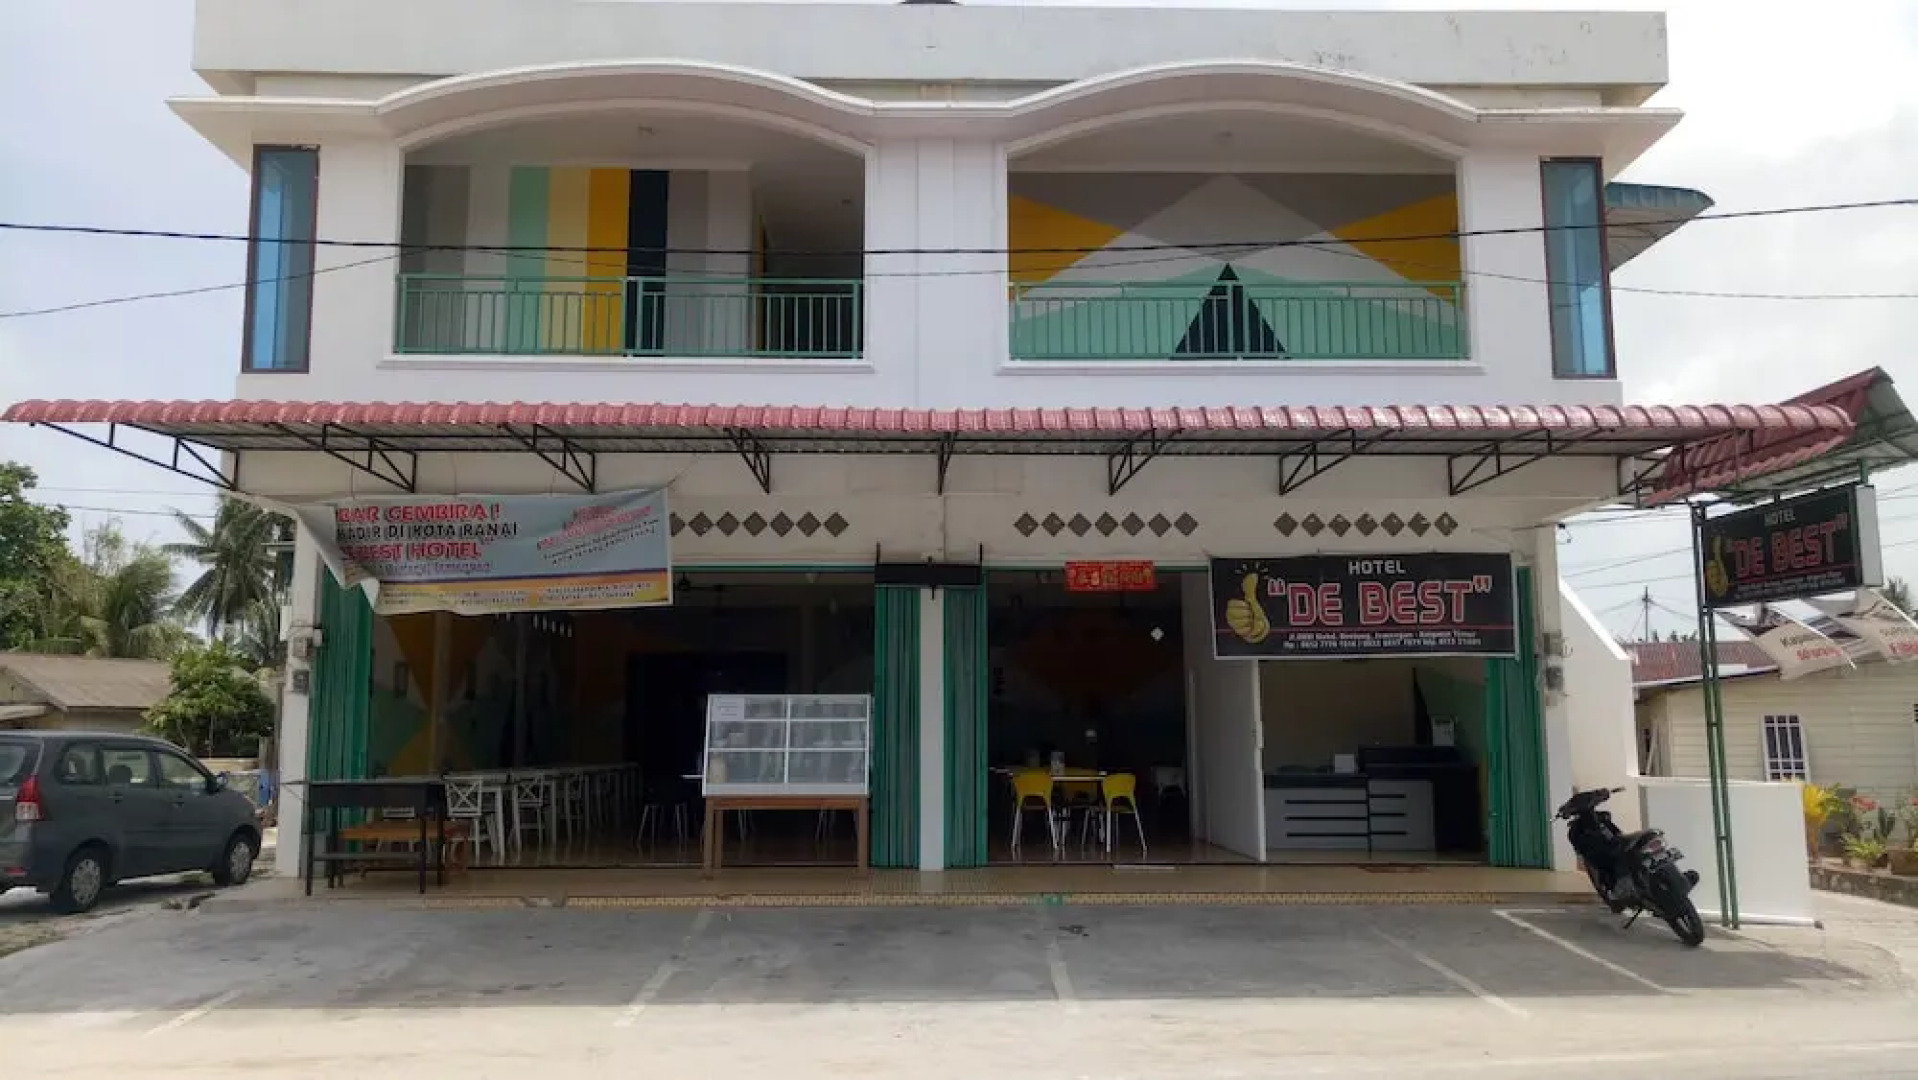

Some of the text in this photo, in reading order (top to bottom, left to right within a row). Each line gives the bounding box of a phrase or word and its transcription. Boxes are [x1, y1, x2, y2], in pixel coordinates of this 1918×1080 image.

[385, 503, 488, 522] GEMBIRA
[387, 525, 404, 538] DI
[411, 524, 456, 538] KOTA
[461, 521, 517, 538] RANAI
[1348, 559, 1406, 575] HOTEL
[1358, 575, 1493, 625] BEST"
